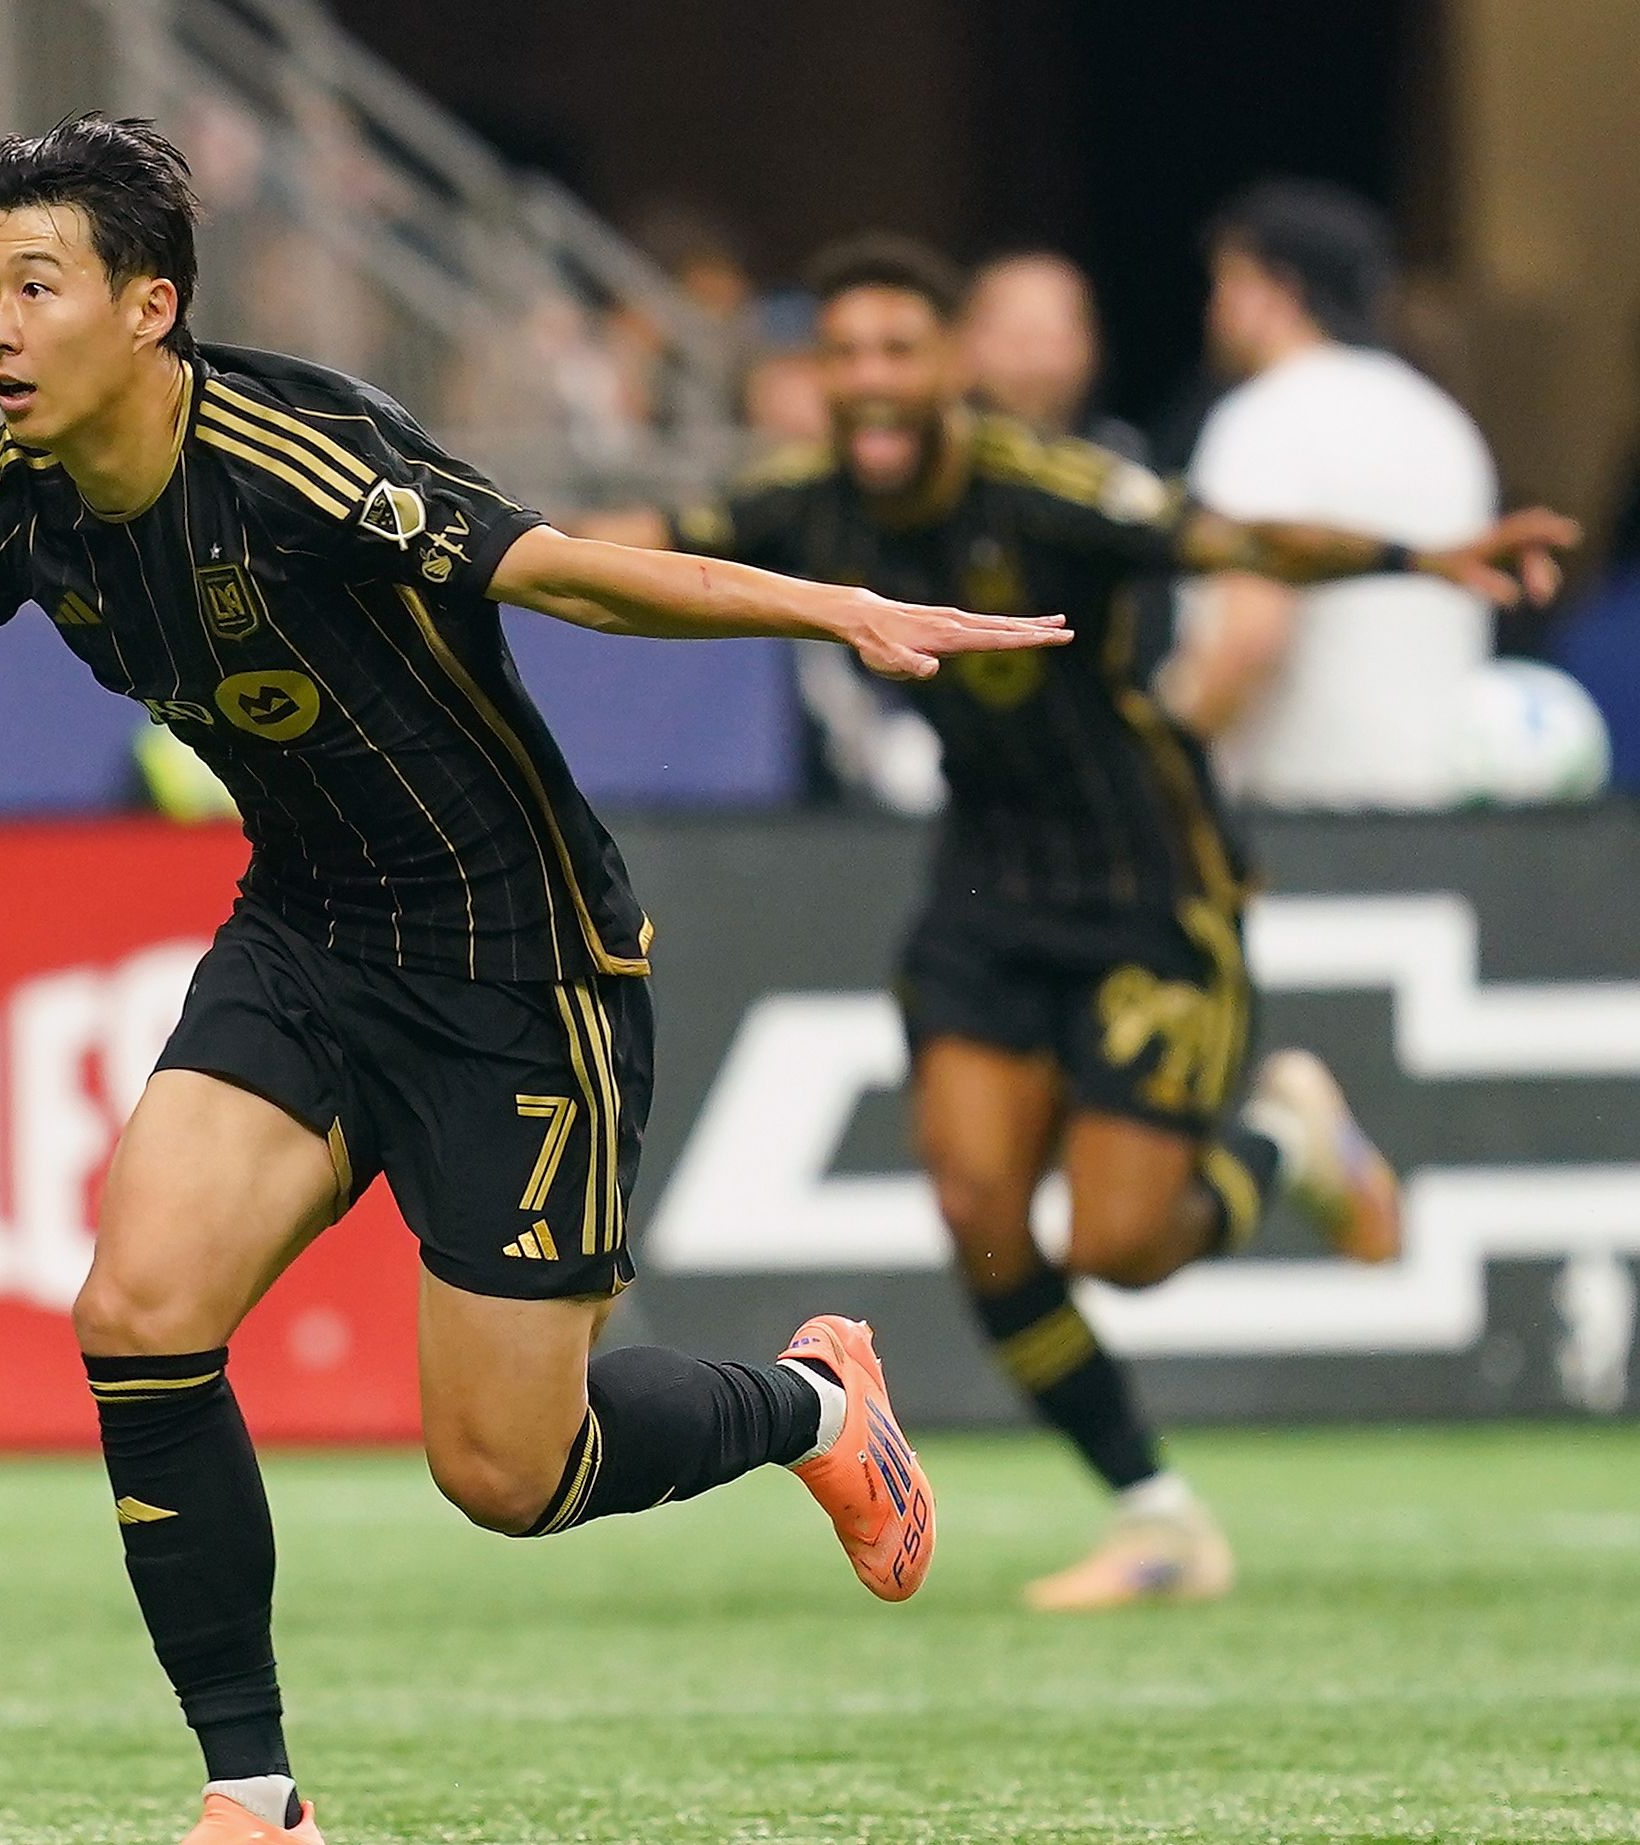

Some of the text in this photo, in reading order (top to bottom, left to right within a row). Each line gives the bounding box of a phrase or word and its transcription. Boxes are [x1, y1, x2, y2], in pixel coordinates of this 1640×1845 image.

[424, 510, 473, 564] tv
[515, 1093, 578, 1212] 7
[892, 1488, 928, 1589] F50
